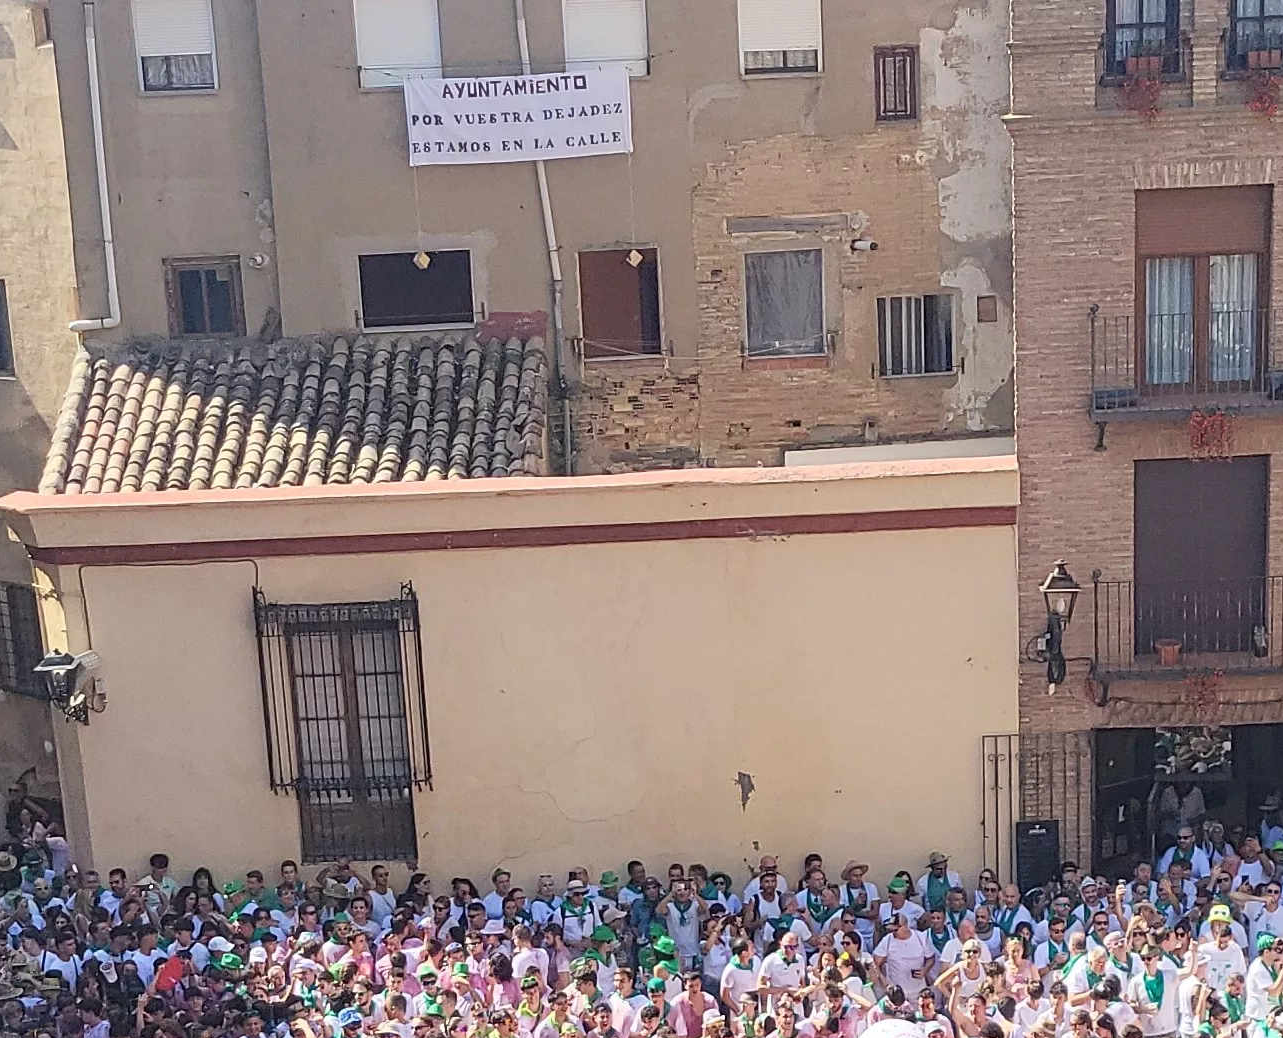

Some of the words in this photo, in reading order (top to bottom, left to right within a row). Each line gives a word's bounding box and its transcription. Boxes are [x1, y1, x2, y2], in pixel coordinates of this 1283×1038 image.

[411, 114, 444, 127] POR
[454, 111, 535, 126] VUESTRA
[543, 102, 624, 121] DEJADEZ
[412, 141, 491, 154] ESTAMOS
[502, 140, 523, 151] EN
[534, 138, 555, 150] LA
[566, 131, 622, 148] CALLE
